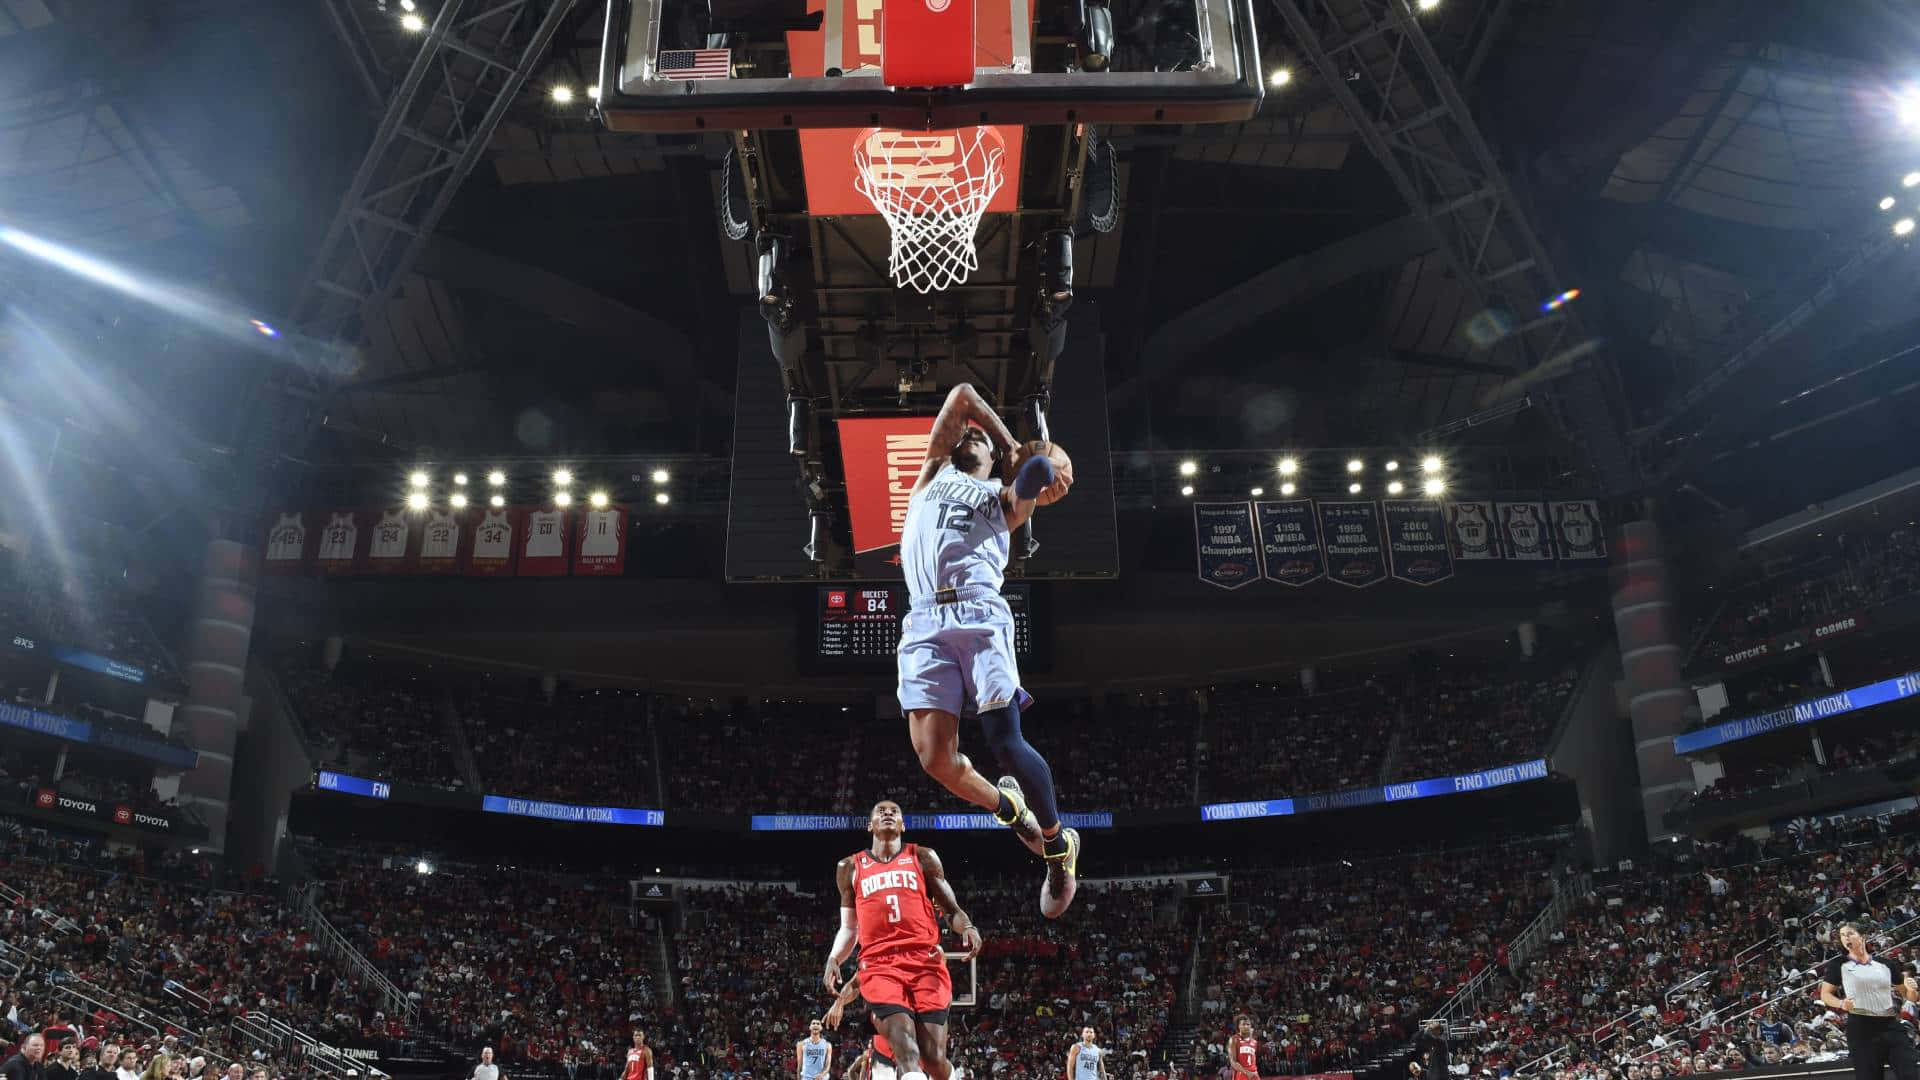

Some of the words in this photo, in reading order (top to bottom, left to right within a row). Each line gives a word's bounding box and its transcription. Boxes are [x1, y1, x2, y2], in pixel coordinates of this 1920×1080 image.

[936, 503, 975, 533] 12
[1213, 525, 1237, 534] 1997
[1275, 523, 1301, 532] 1998
[1338, 524, 1363, 533] 1999
[331, 530, 346, 544] 23
[383, 529, 398, 542] 24
[484, 530, 502, 543] 34
[1211, 535, 1242, 544] WNBA
[1274, 533, 1305, 543] WNBA
[1336, 534, 1368, 544] WNBA
[1201, 546, 1253, 556] Champions
[1265, 543, 1318, 554] Champions
[1328, 544, 1379, 555] Champions
[1392, 543, 1446, 553] Champions
[867, 599, 888, 612] 84
[1815, 618, 1856, 637] CORNER
[13, 636, 35, 649] axs
[1724, 644, 1768, 665] CLUTCH'S
[32, 711, 72, 735] WINS
[1720, 722, 1744, 741] NEW
[1745, 704, 1814, 737] AMSTERDAM
[1815, 694, 1852, 716] VODKA
[1204, 806, 1236, 819] YOUR
[1237, 803, 1267, 816] WINS
[1389, 784, 1418, 800] VODKA
[1454, 776, 1483, 791] FIND
[1485, 767, 1517, 786] YOUR
[1518, 760, 1547, 780] WINS
[58, 797, 97, 813] TOYOTA
[507, 800, 526, 814] NEW
[529, 802, 584, 820] AMSTERDAM
[586, 808, 613, 822] VODKA
[134, 813, 169, 828] TOYOTA
[774, 816, 793, 830] NEW
[794, 816, 849, 830] AMSTERDAM
[911, 815, 936, 828] FIND
[938, 814, 972, 829] YOUR
[974, 814, 1000, 829] WINS
[861, 870, 918, 899] ROCKETS
[886, 894, 901, 923] 3
[343, 1048, 380, 1060] TUNNEL
[812, 1056, 818, 1065] 7
